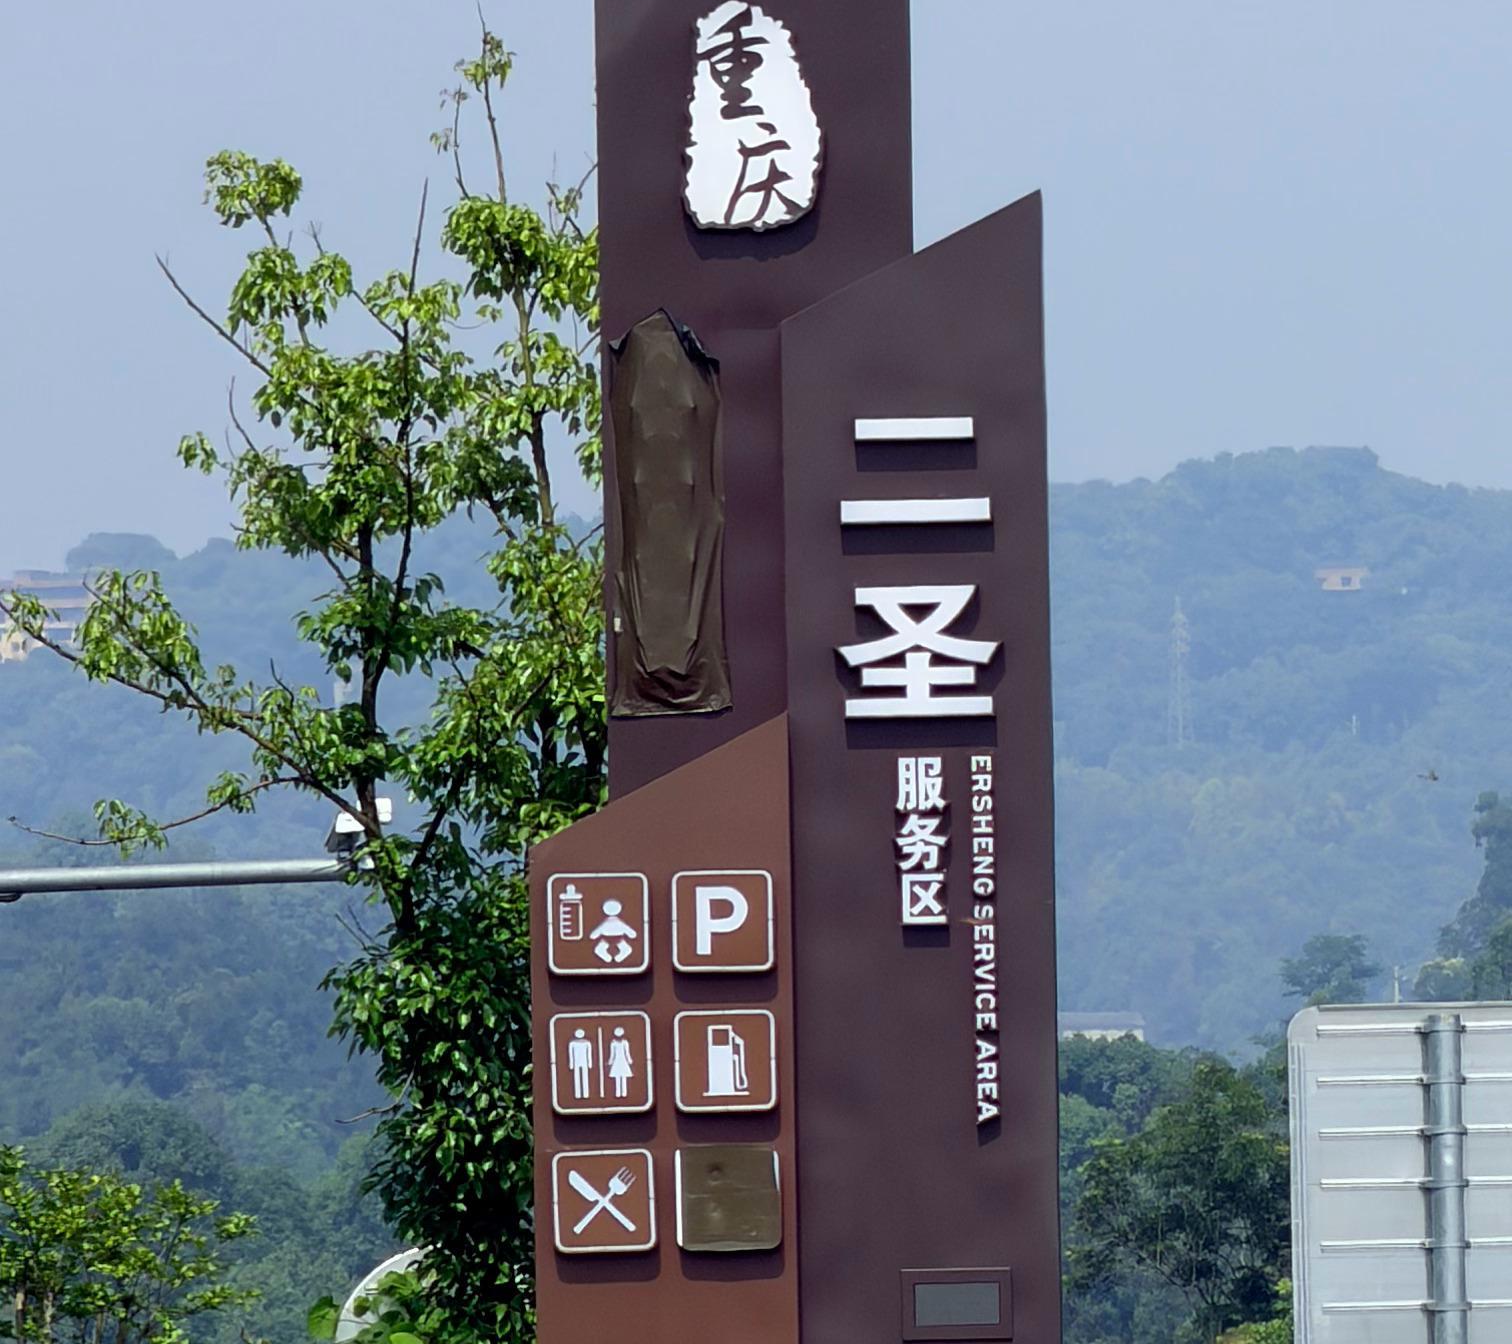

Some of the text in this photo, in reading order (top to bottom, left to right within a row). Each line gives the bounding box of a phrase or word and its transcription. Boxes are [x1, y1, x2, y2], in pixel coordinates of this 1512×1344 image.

[694, 4, 802, 225] 重庆
[839, 416, 998, 718] 二圣
[695, 885, 749, 955] P
[896, 756, 948, 924] 服务区
[970, 755, 999, 1123] ERSHENG SERVICE AREA
